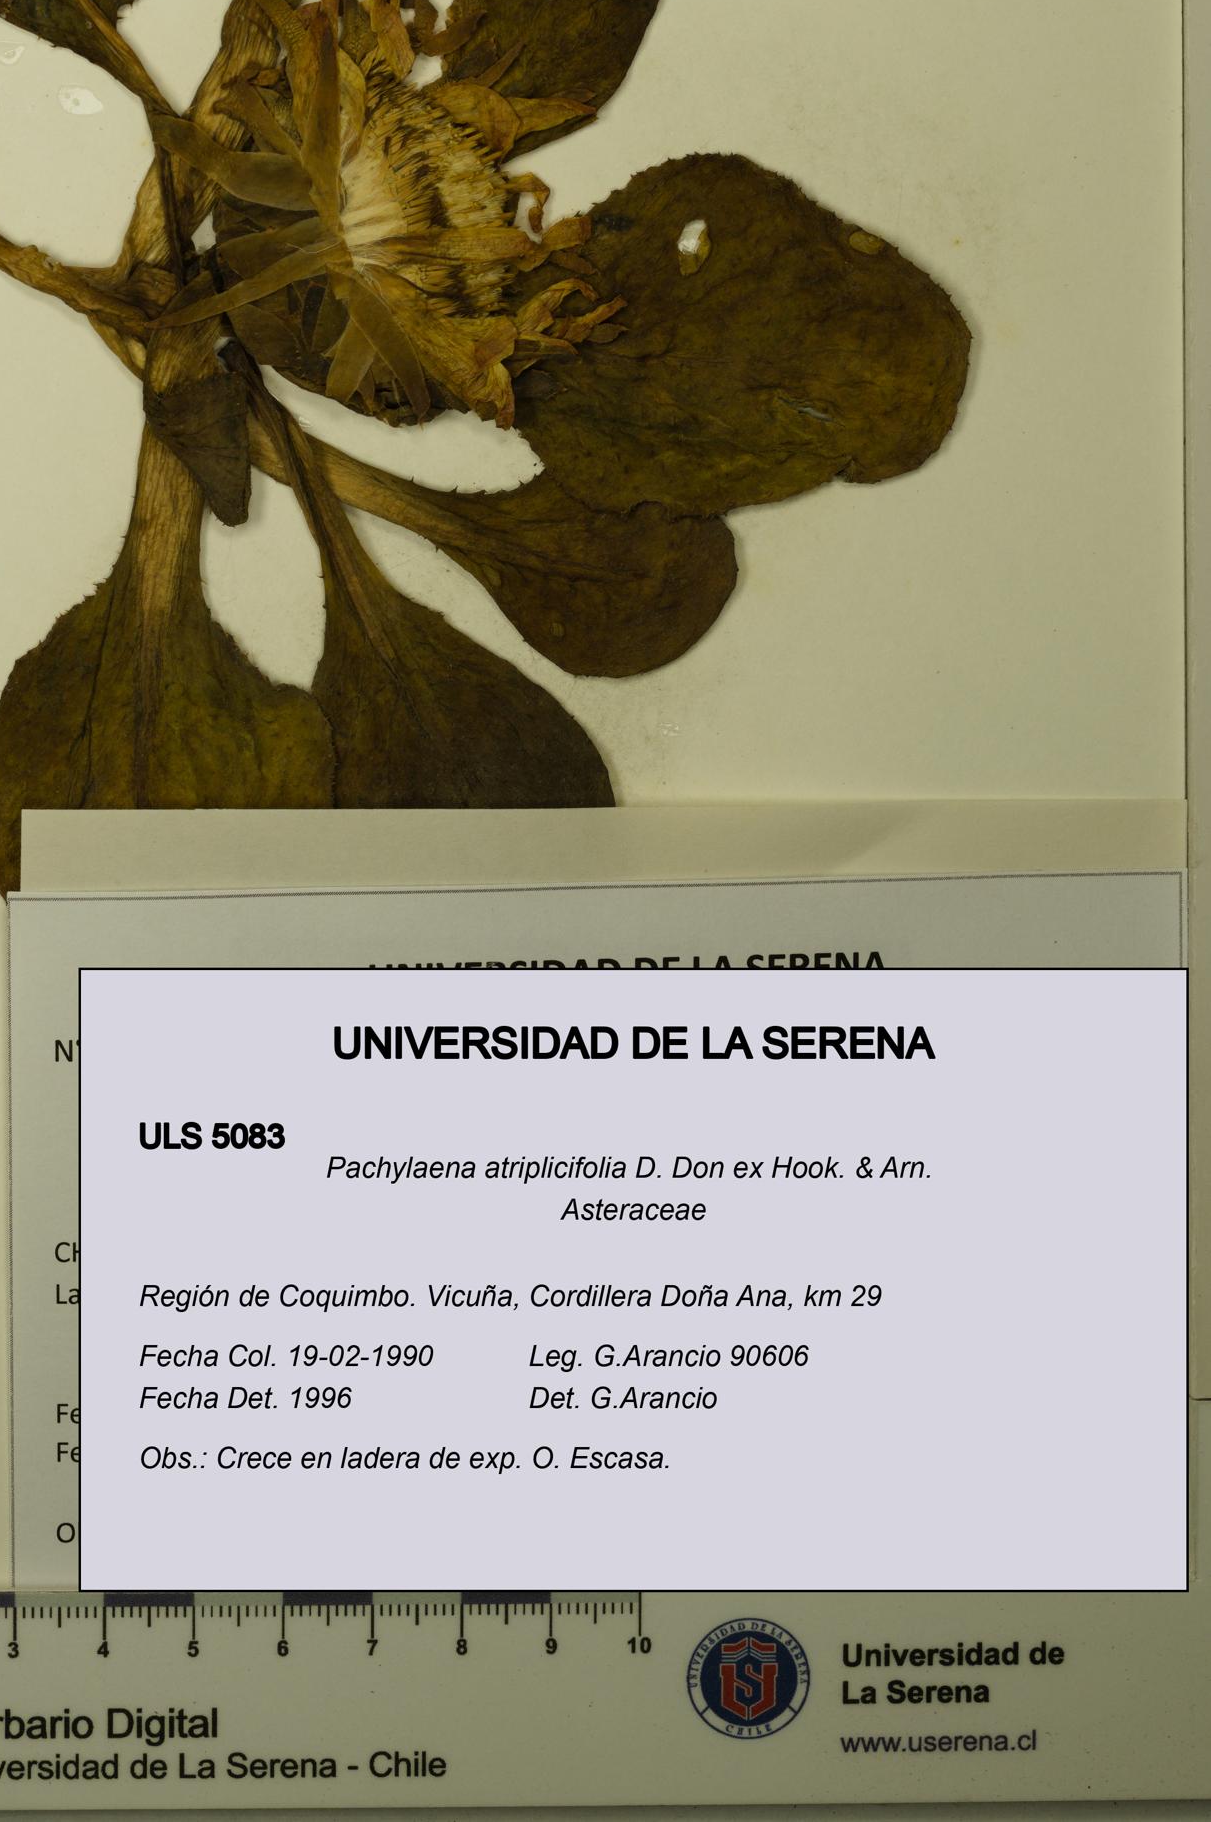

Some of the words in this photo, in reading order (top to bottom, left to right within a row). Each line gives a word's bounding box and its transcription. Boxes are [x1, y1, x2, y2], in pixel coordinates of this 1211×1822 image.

[8, 1641, 20, 1659] 3
[97, 1641, 110, 1658] 4
[187, 1640, 200, 1658] 5
[277, 1639, 289, 1657] 6
[366, 1638, 379, 1656] 7
[455, 1638, 468, 1656] 8
[545, 1637, 558, 1655] 9
[627, 1636, 652, 1655] 10
[842, 1641, 1020, 1668] Universidad
[1028, 1640, 1065, 1666] de
[842, 1680, 878, 1706] La
[886, 1679, 990, 1705] Serena
[107, 1706, 218, 1747] Digital
[840, 1728, 1038, 1754] www.userena.cl
[129, 1752, 168, 1780] de
[178, 1752, 216, 1780] La
[226, 1751, 337, 1780] Serena
[369, 1750, 447, 1778] Chile
